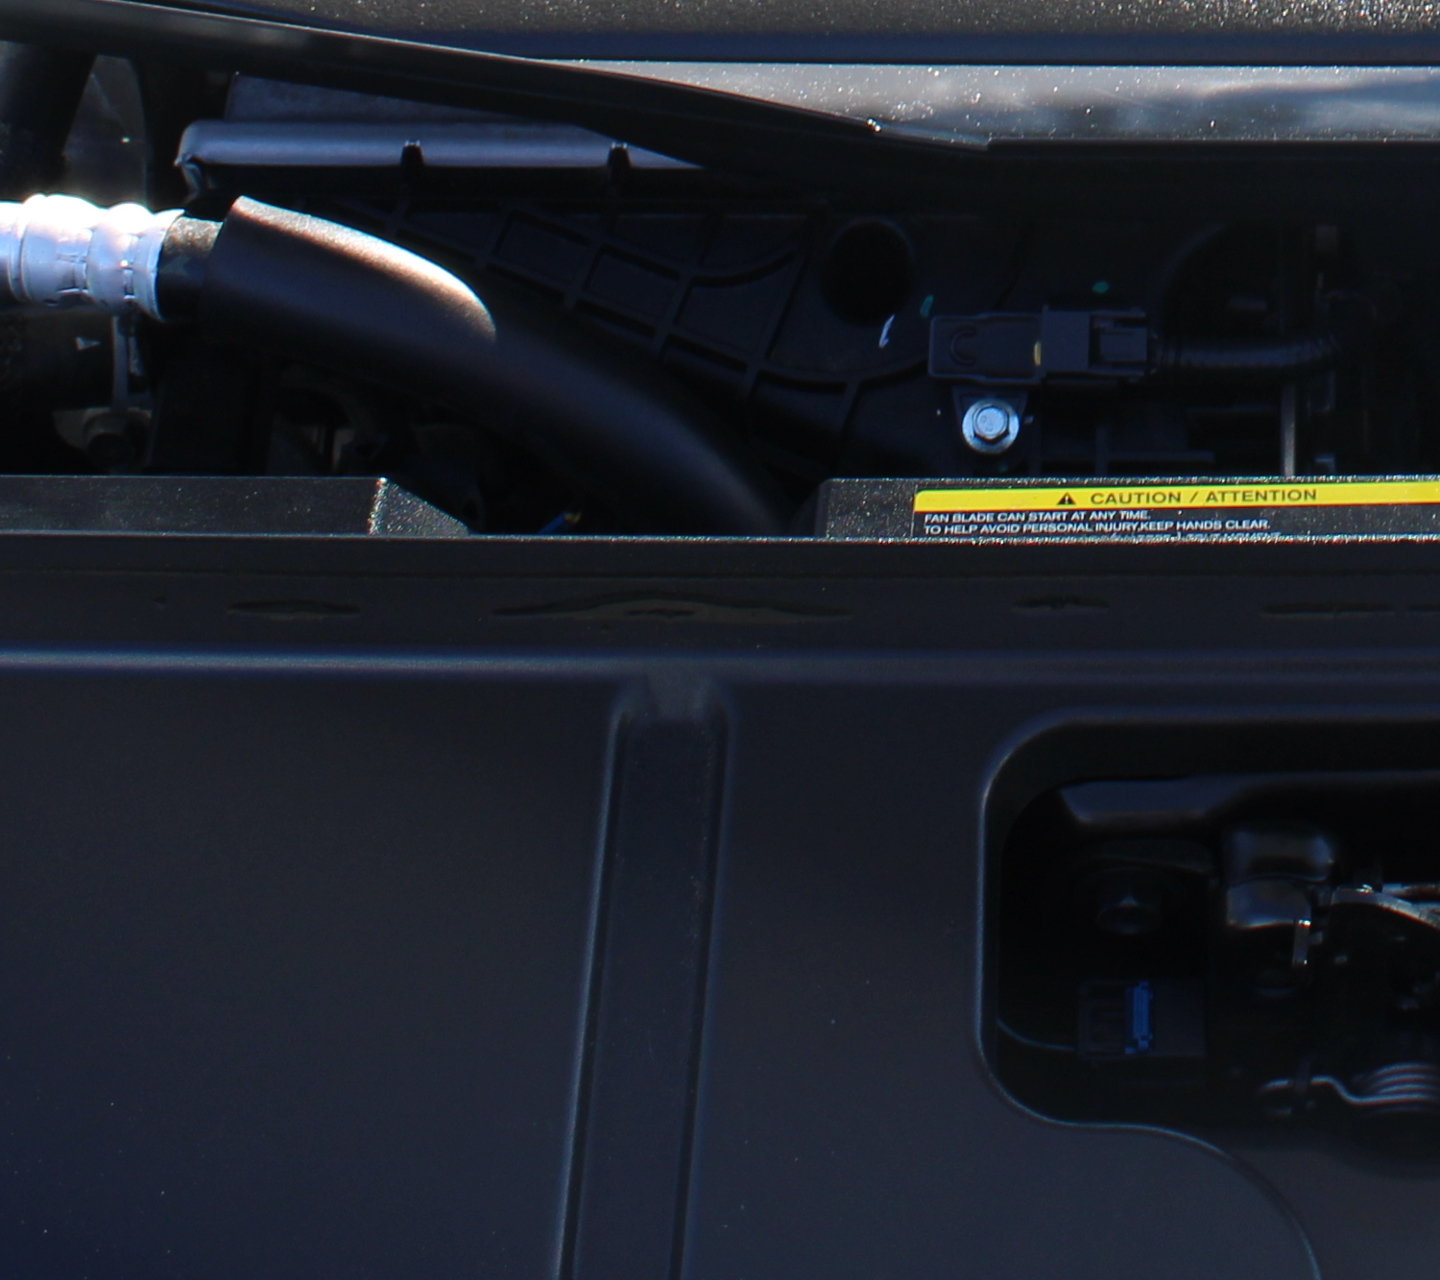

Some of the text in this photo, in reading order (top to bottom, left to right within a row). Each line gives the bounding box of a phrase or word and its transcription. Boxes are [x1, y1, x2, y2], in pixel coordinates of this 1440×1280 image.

[1090, 491, 1181, 505] CAUTION
[1205, 489, 1317, 503] ATTENTION
[924, 513, 949, 523] FAN
[952, 513, 994, 523] BLADE
[997, 512, 1025, 522] CAN
[1028, 512, 1068, 522] START
[1070, 511, 1086, 521] AT
[1089, 511, 1115, 520] ANY
[924, 524, 942, 535] TO
[944, 524, 977, 534] HELP
[980, 523, 1020, 534] AVOID
[1023, 522, 1093, 533] PERSONAL
[1176, 520, 1223, 531] HANDS
